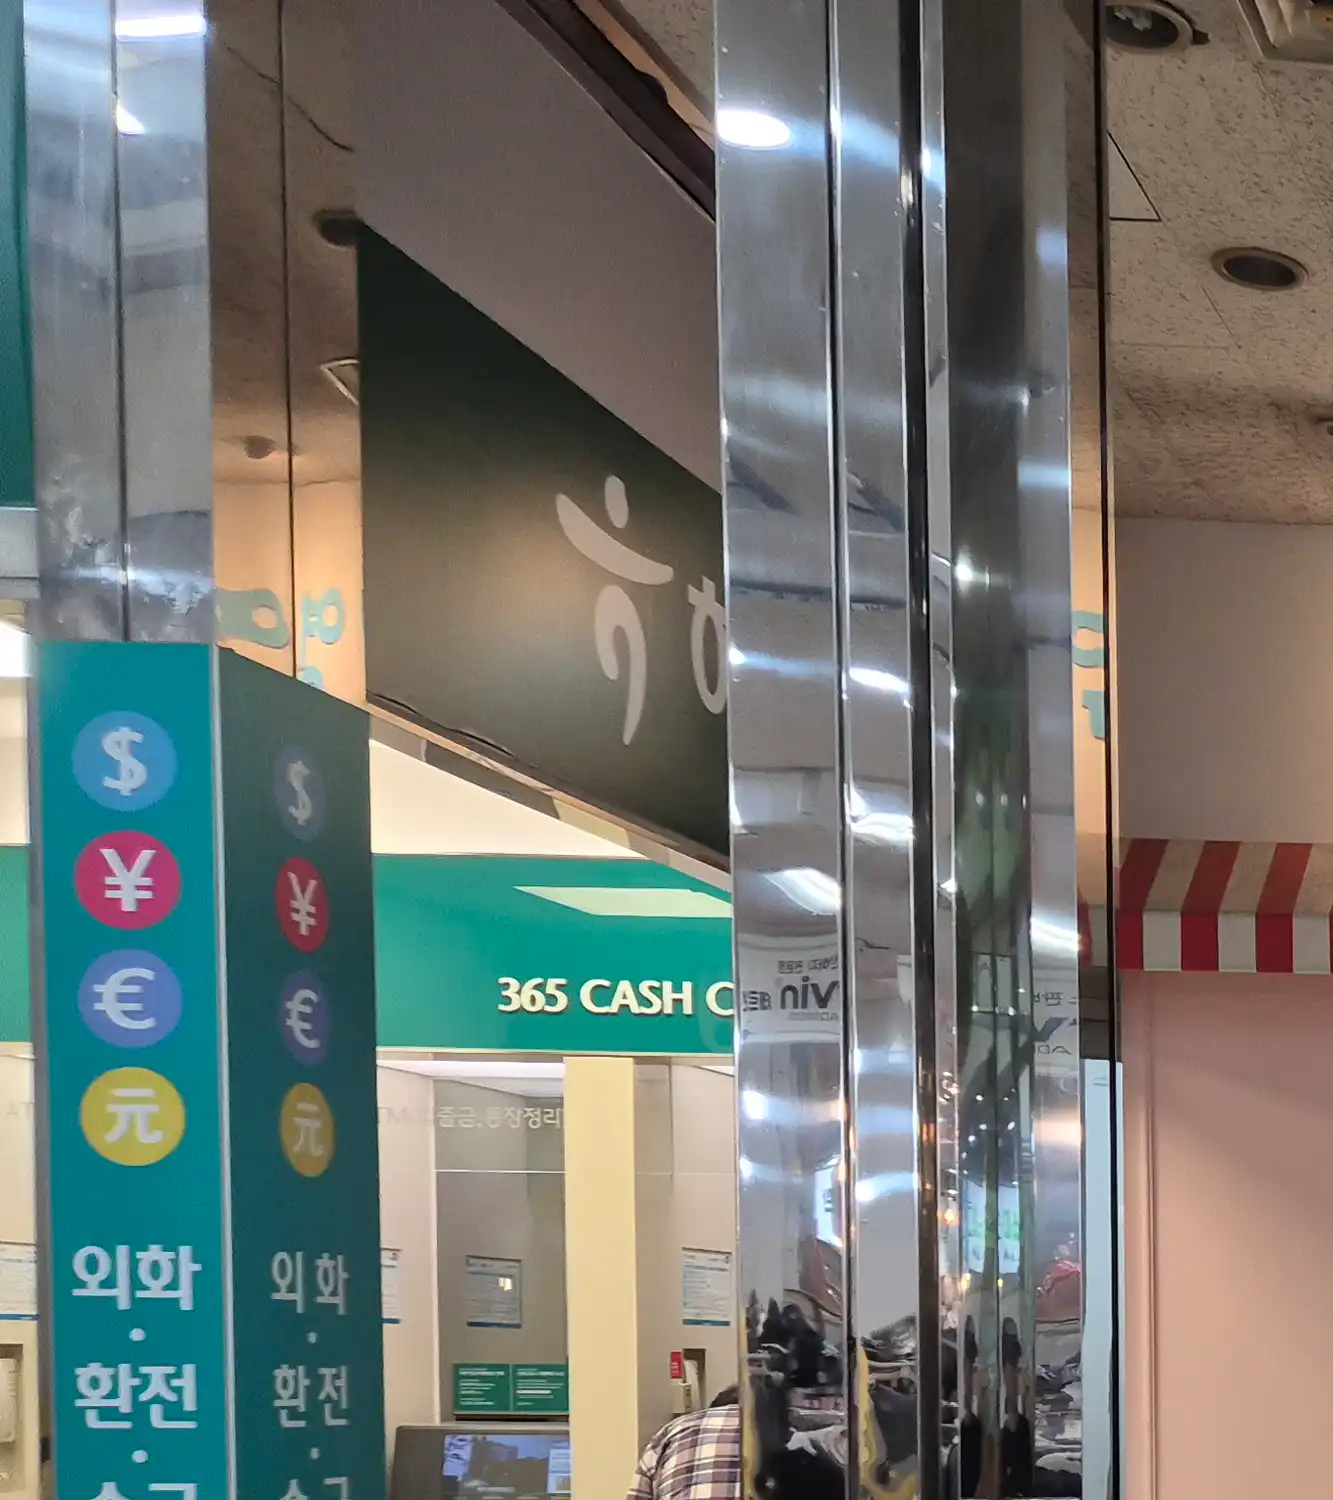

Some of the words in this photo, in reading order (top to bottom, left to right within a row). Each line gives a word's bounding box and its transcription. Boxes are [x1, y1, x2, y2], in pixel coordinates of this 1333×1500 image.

[498, 977, 568, 1013] 365
[579, 979, 693, 1016] CASH
[104, 1088, 163, 1144] 元
[72, 1244, 202, 1310] 외화
[271, 1250, 350, 1316] 외화
[74, 1362, 198, 1429] 환전
[273, 1363, 349, 1429] 환전
